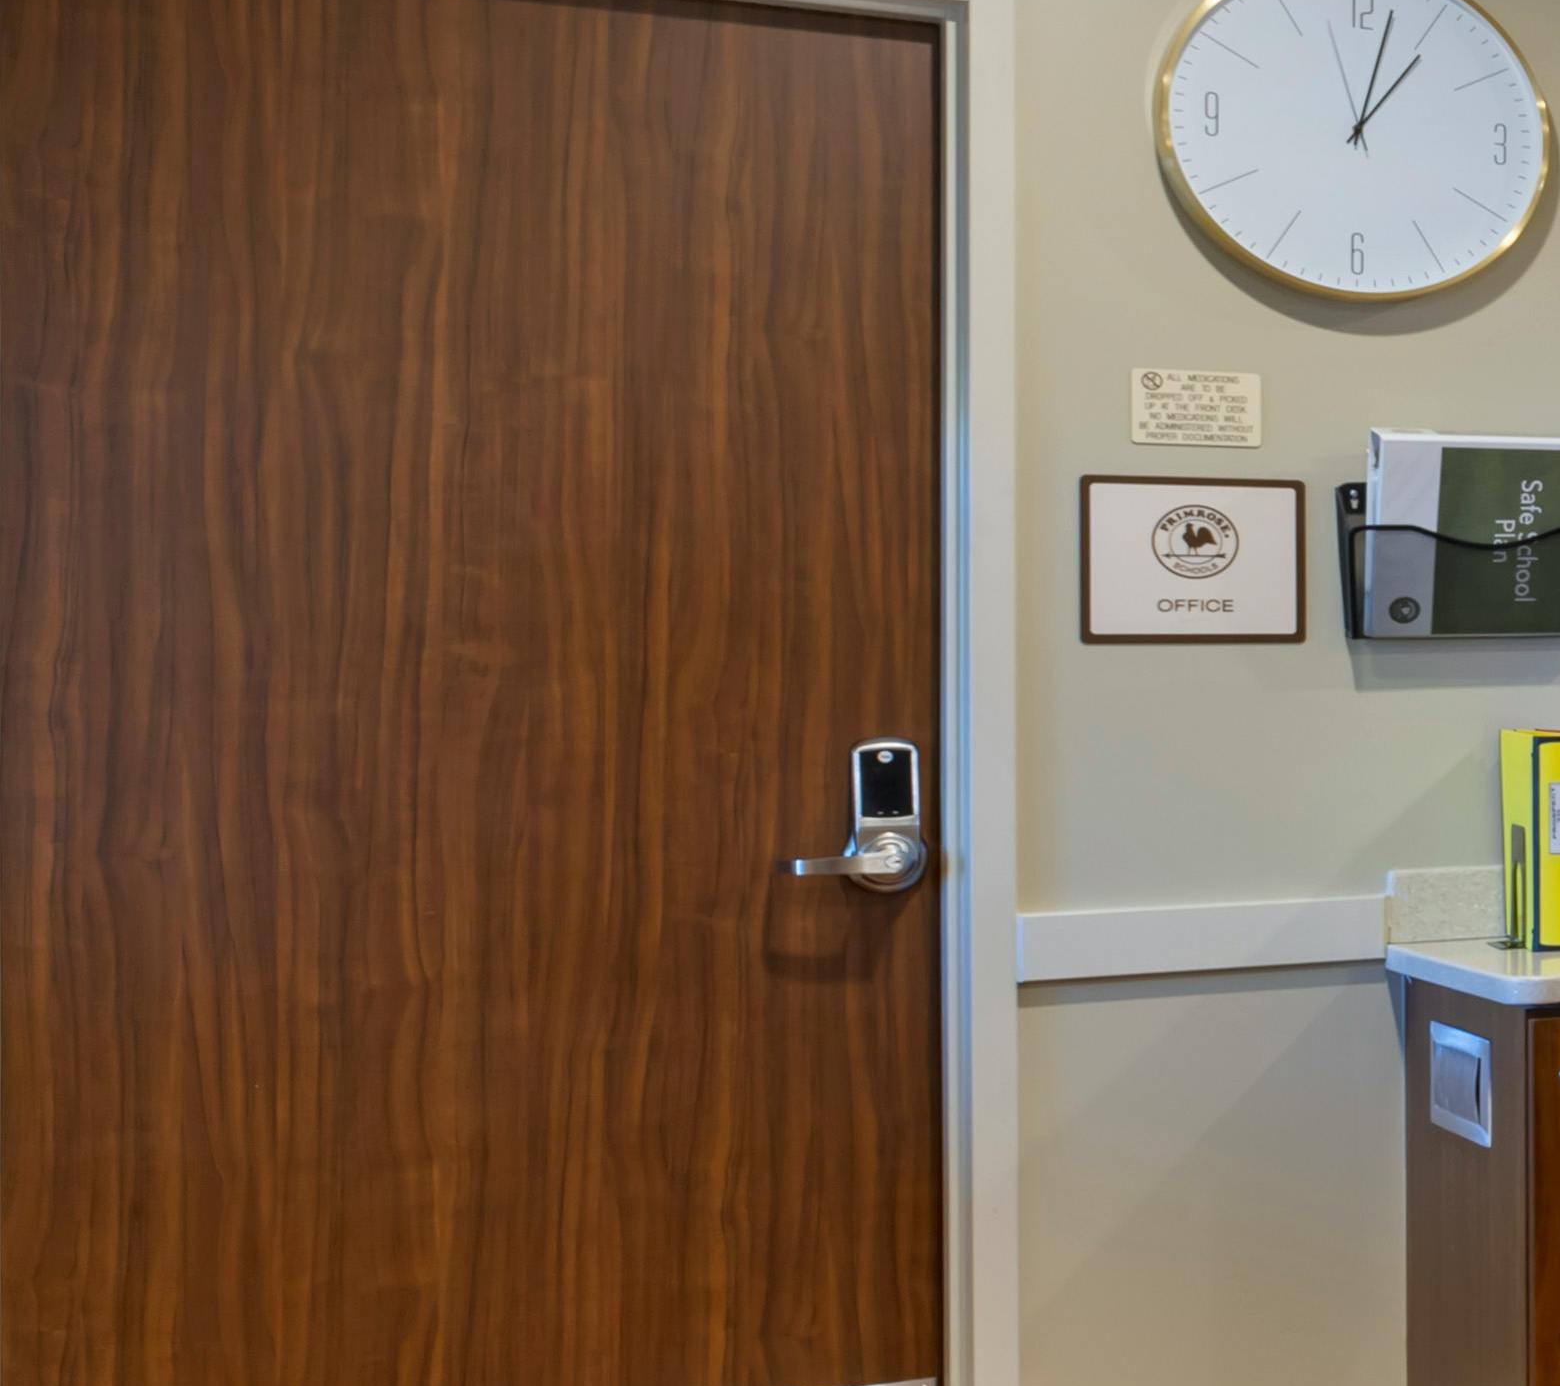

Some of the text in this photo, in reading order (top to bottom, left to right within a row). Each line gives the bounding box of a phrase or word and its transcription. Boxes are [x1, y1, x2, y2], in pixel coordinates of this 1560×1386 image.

[1203, 91, 1220, 137] 9
[1493, 123, 1508, 165] 3
[1350, 231, 1365, 275] 6
[1160, 509, 1231, 533] PRIMROSE
[1519, 480, 1543, 525] Safe
[1157, 598, 1234, 613] OFFICE
